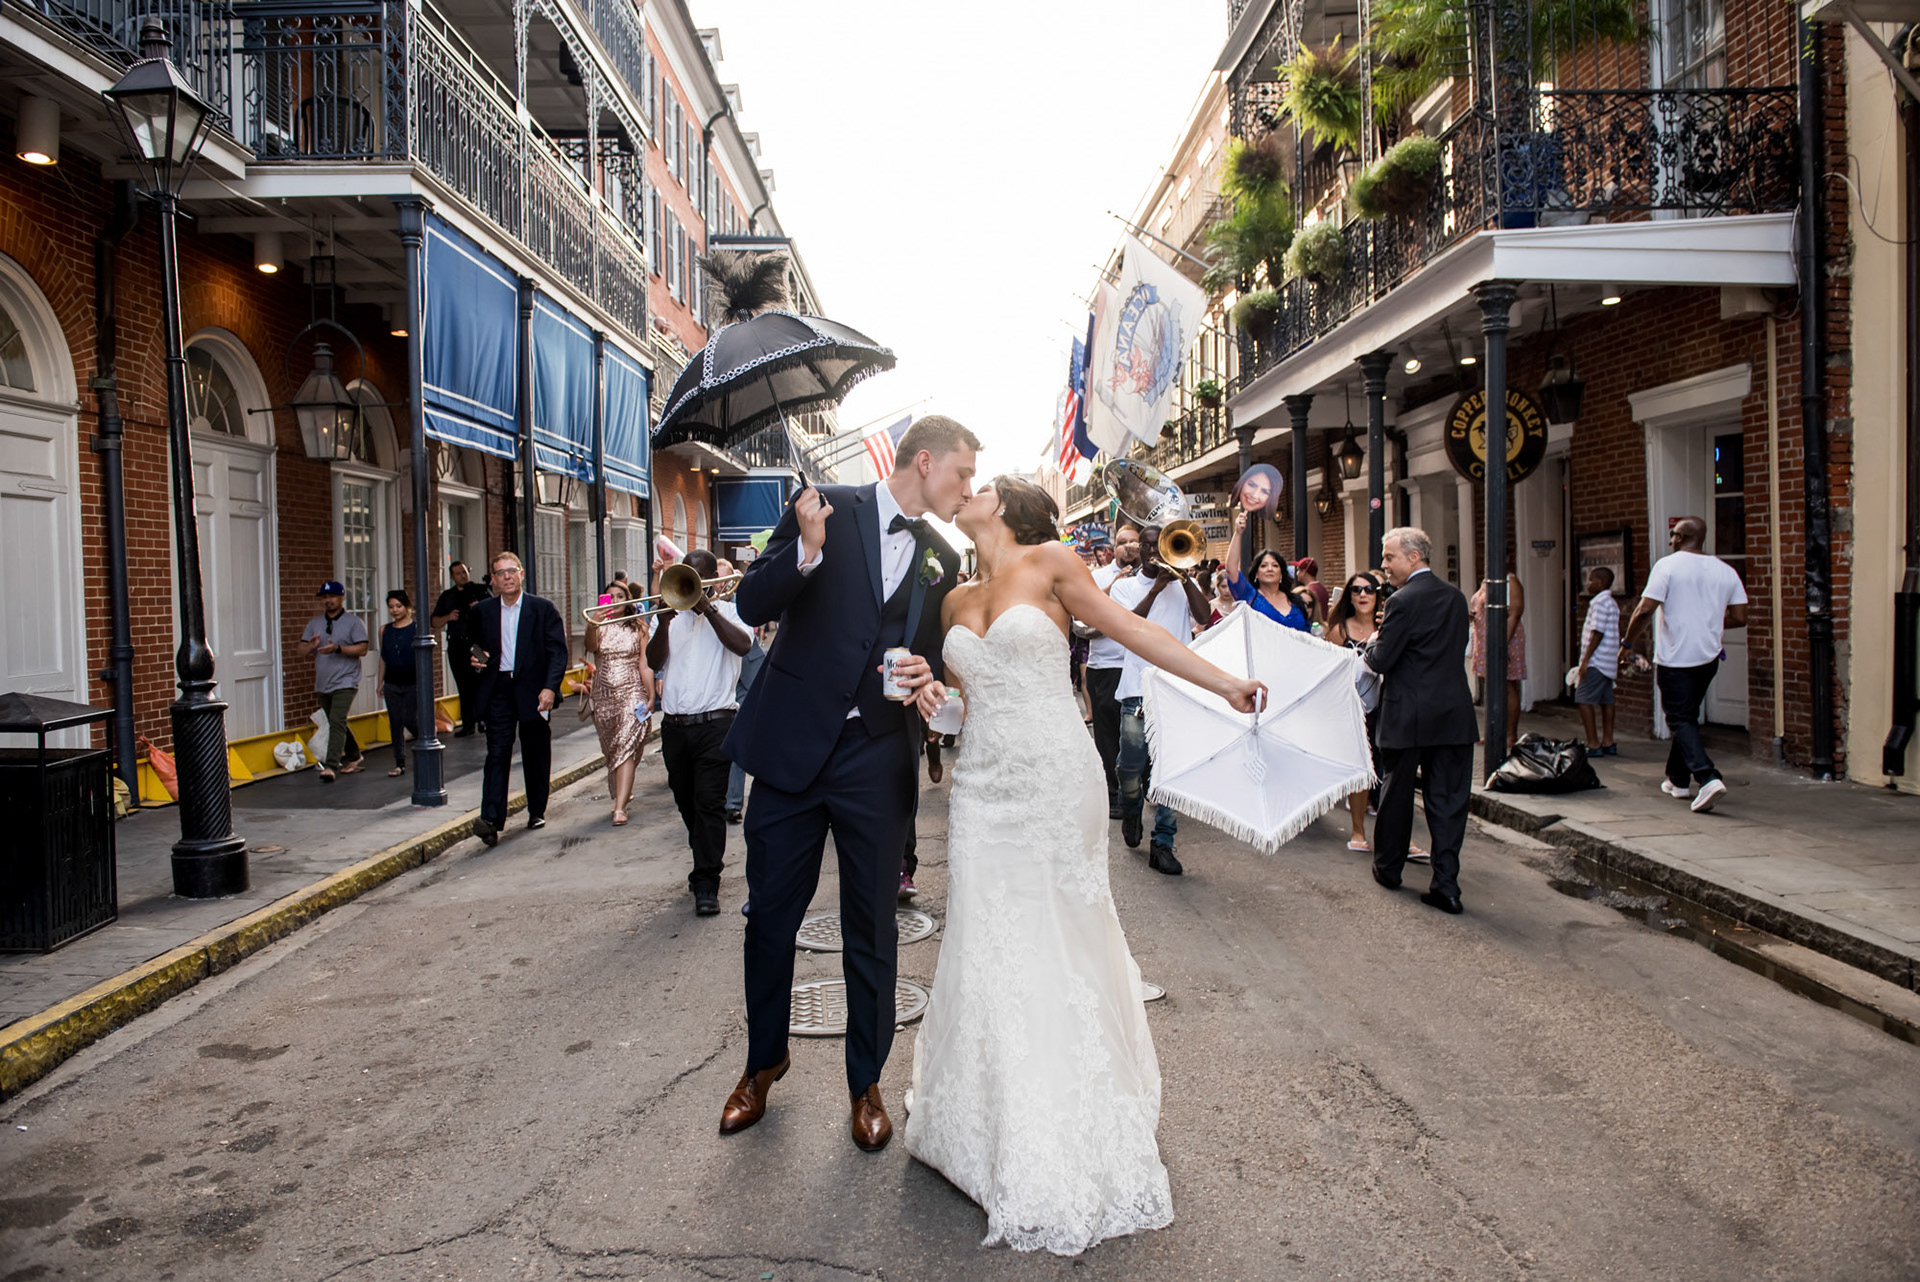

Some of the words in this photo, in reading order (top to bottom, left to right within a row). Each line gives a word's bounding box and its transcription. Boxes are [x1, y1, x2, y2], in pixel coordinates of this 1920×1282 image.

[1469, 462, 1528, 480] GLL
[1195, 494, 1216, 503] Olde
[1073, 522, 1108, 536] OCEANA
[1204, 526, 1228, 539] KERY
